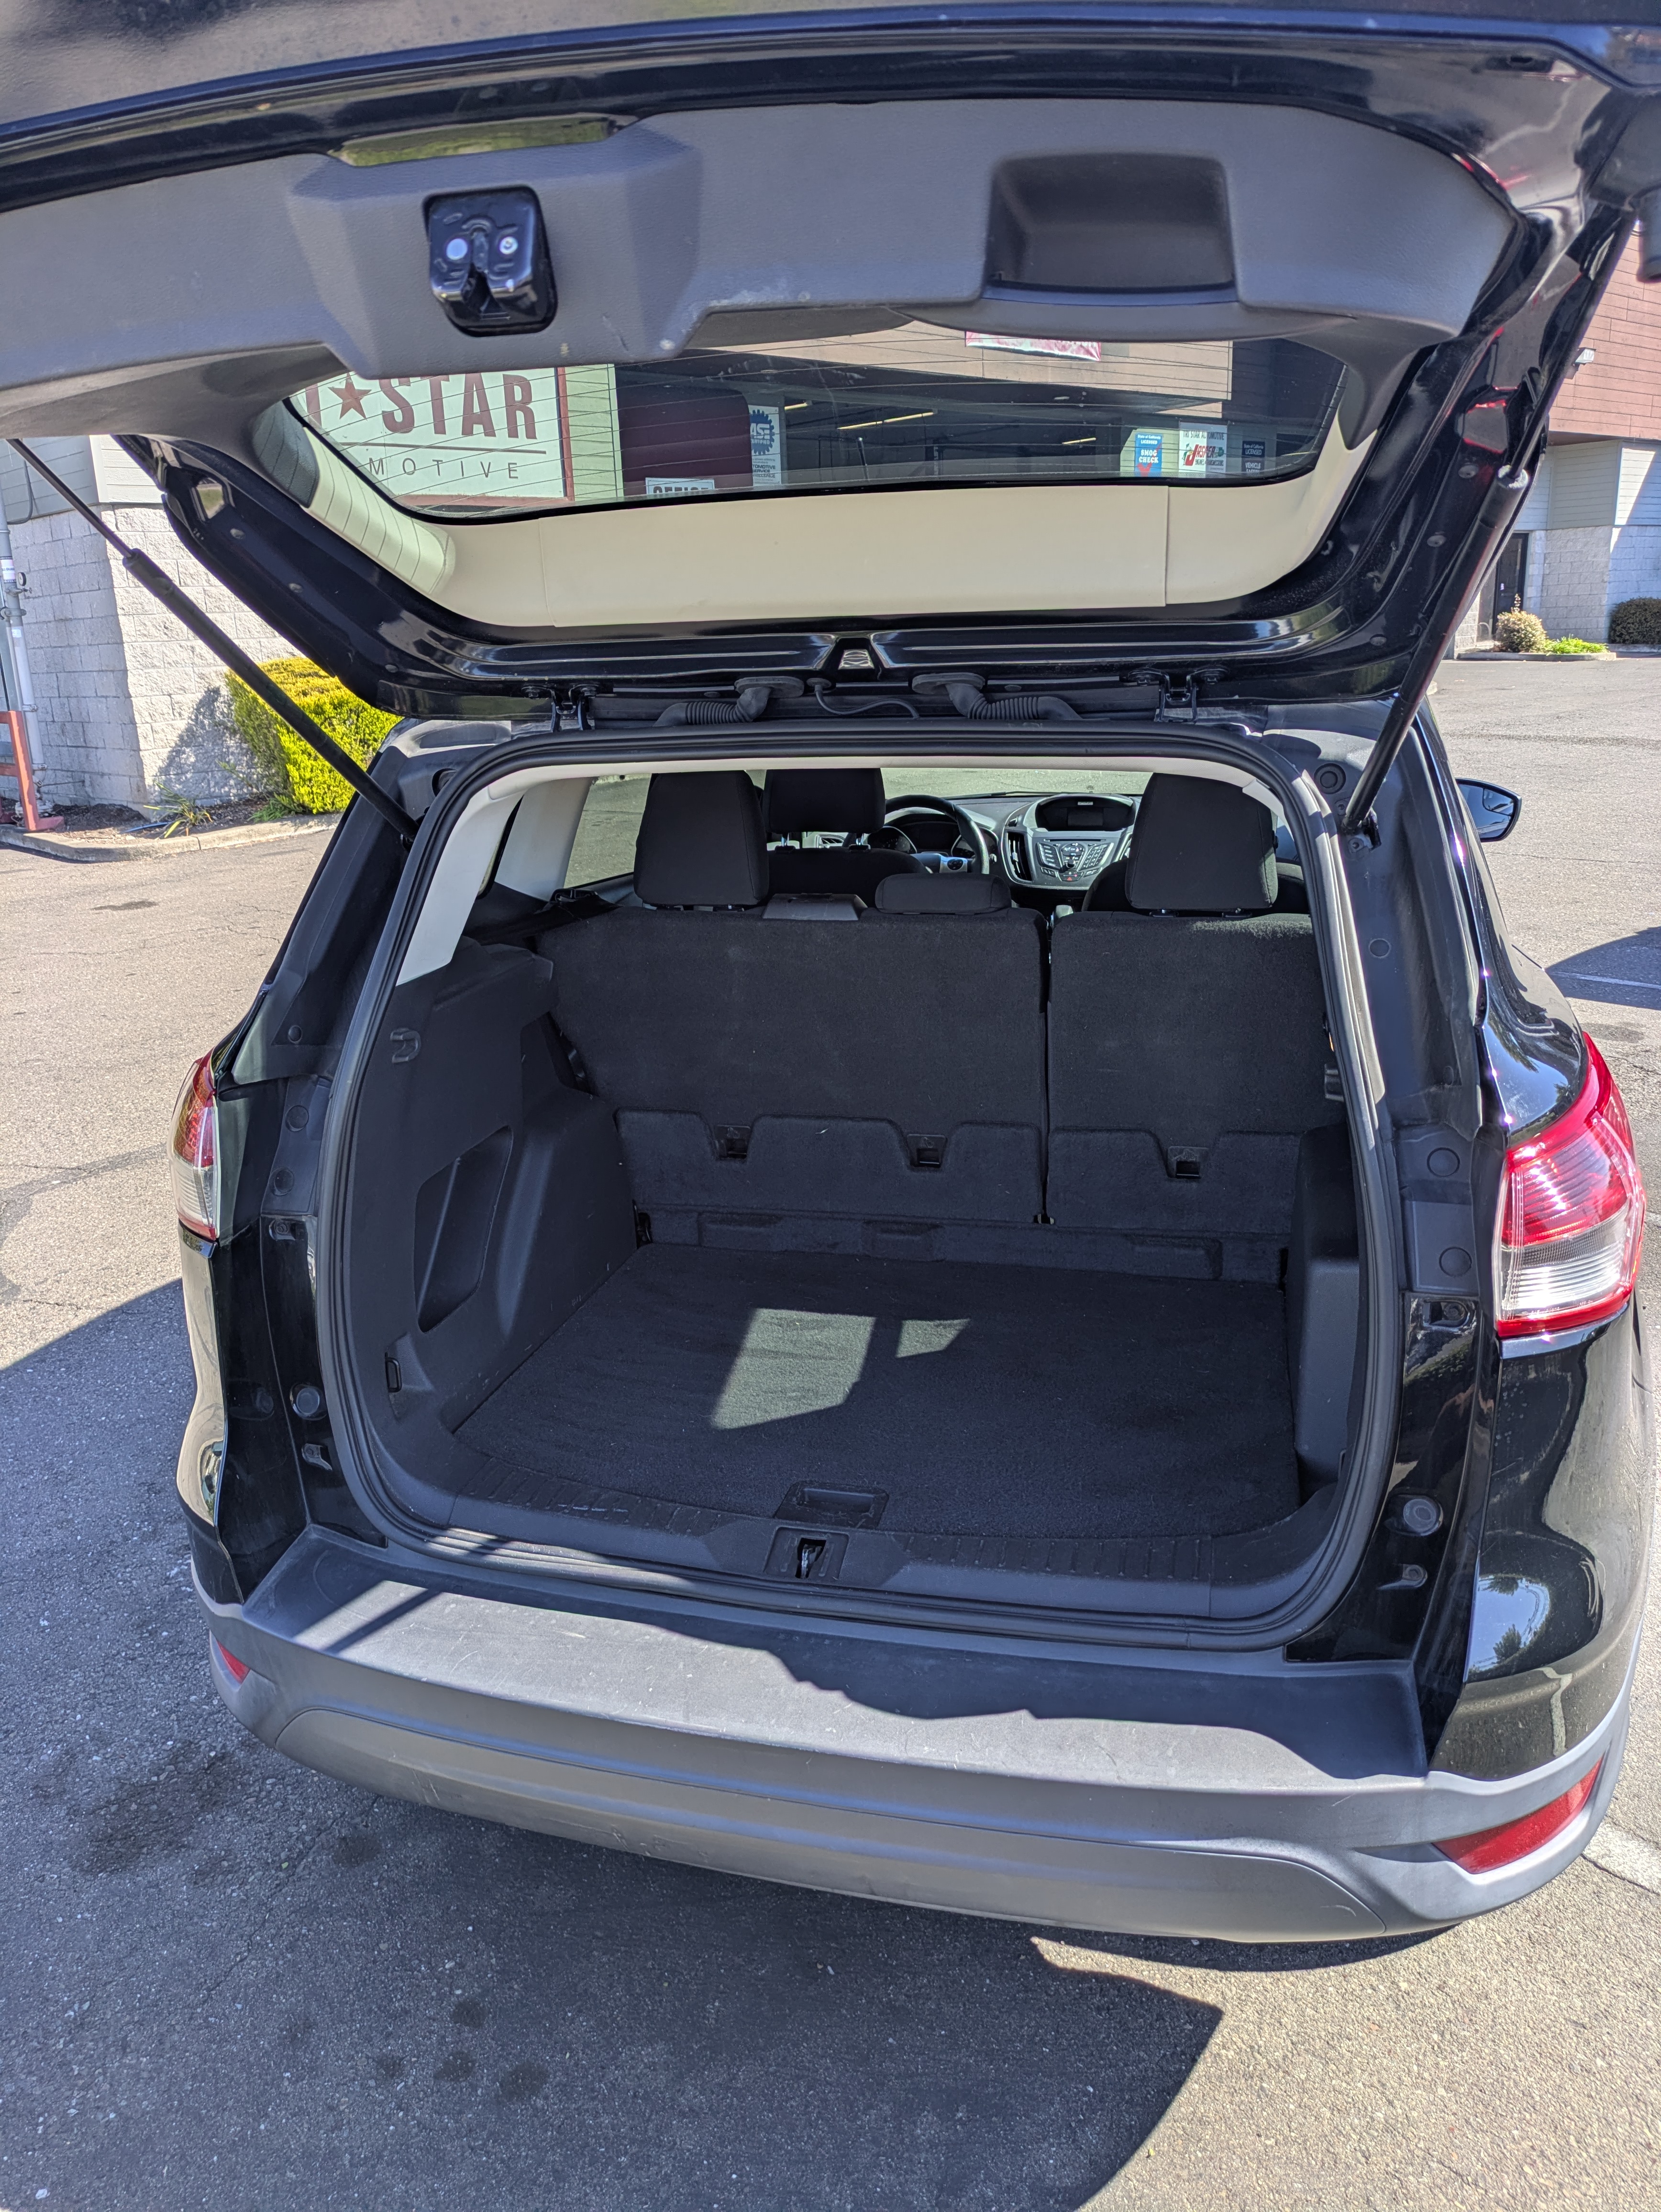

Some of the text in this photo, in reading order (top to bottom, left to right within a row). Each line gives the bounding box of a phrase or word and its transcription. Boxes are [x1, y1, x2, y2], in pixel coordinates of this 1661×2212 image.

[378, 372, 537, 440] STAR
[1191, 431, 1200, 439] STAR
[1201, 431, 1224, 440] AUTOMOTIVE
[1185, 444, 1216, 466] JASPER
[369, 457, 519, 479] MOTIVE
